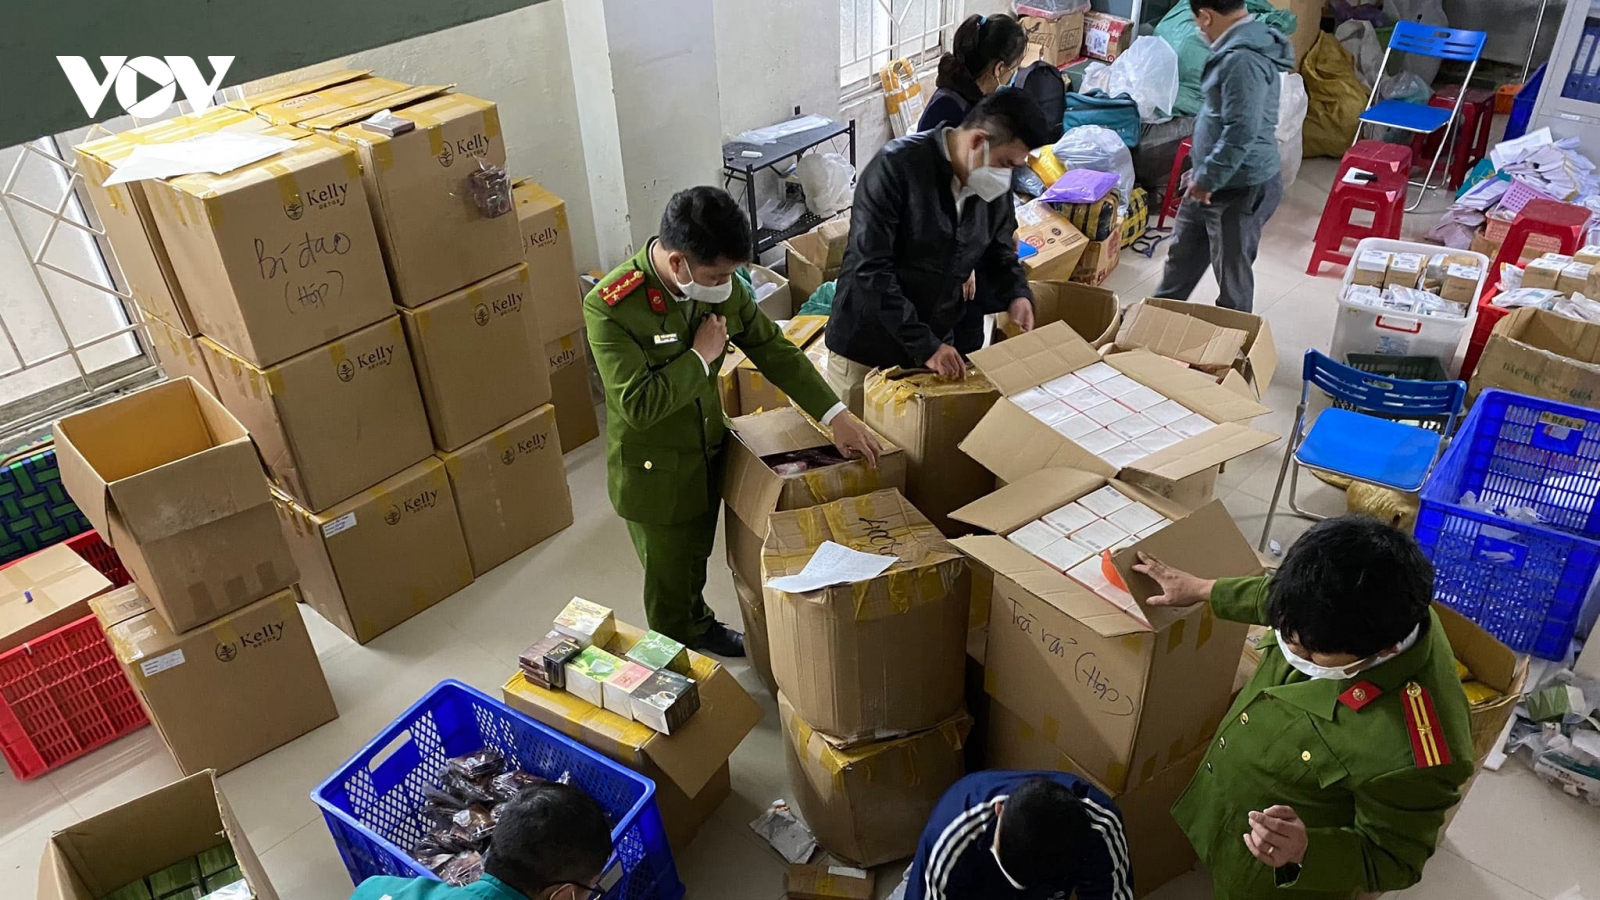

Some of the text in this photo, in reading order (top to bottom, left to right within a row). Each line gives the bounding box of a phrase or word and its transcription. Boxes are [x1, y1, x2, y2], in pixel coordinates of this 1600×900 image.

[457, 133, 490, 156] Kelly
[306, 183, 348, 207] Kelly
[530, 227, 558, 246] Kelly
[492, 292, 523, 313] Kelly
[357, 344, 394, 369] Kelly
[549, 349, 576, 367] Kelly
[517, 432, 548, 453] Kelly
[403, 489, 438, 513] Kelly
[240, 620, 285, 648] Kelly
